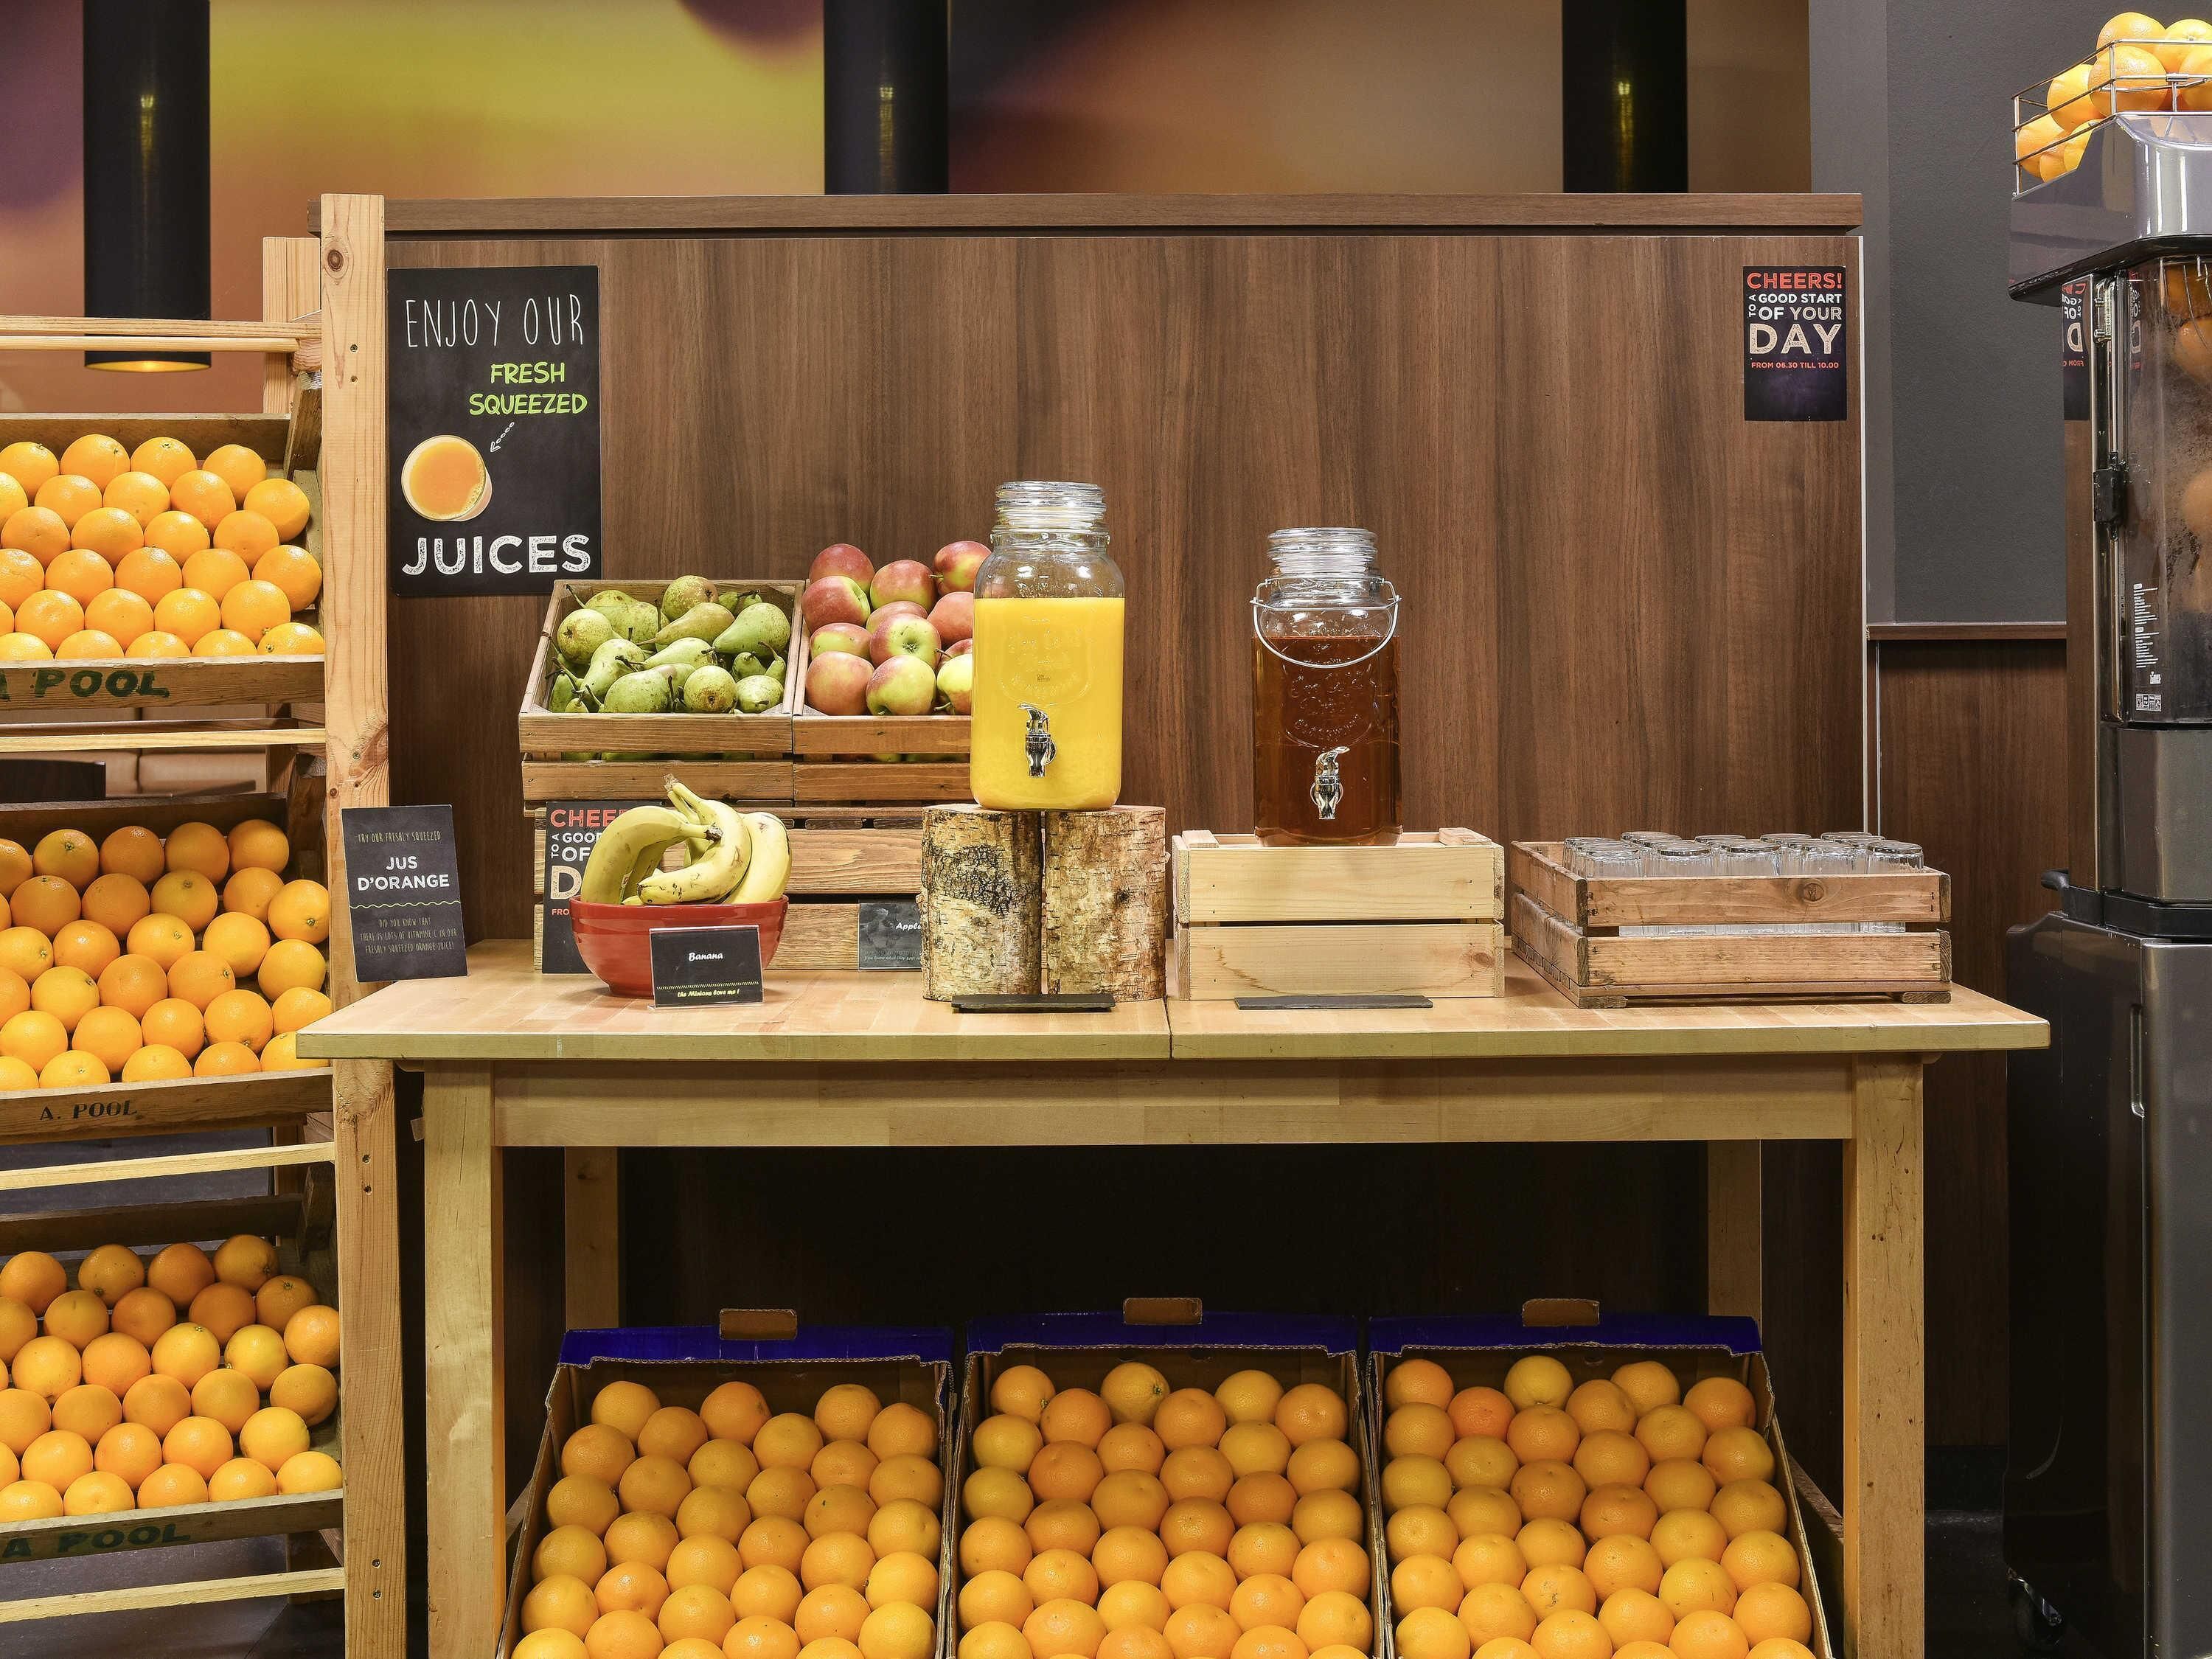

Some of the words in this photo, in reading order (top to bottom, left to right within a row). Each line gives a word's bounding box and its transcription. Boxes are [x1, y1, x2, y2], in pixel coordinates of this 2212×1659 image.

[1747, 272, 1842, 289] CHEERS!
[1758, 293, 1798, 304] GOOD
[1801, 293, 1842, 304] START
[1748, 304, 1756, 318] TO
[1758, 306, 1784, 321] OF
[1790, 306, 1842, 321] YOUR
[406, 299, 501, 348] ENJOY
[524, 294, 583, 345] OUR
[1750, 323, 1842, 355] DAY
[490, 361, 566, 384] FRESH
[468, 393, 588, 415] SQUEEZED
[401, 534, 591, 574] JUICES
[35, 669, 170, 698] POOL
[550, 809, 628, 827] CHEE
[358, 833, 369, 843] TRY
[372, 832, 383, 843] OUR
[385, 832, 409, 842] FRESHLY
[411, 830, 441, 841] SQUEEZED
[562, 846, 591, 862] OF
[386, 855, 418, 871] JUS
[358, 874, 450, 891] D'ORANGE
[688, 952, 723, 961] Banana
[40, 1106, 60, 1120] A.
[73, 1100, 137, 1119] POOL
[2, 1537, 32, 1558] A
[58, 1523, 191, 1553] POOL
